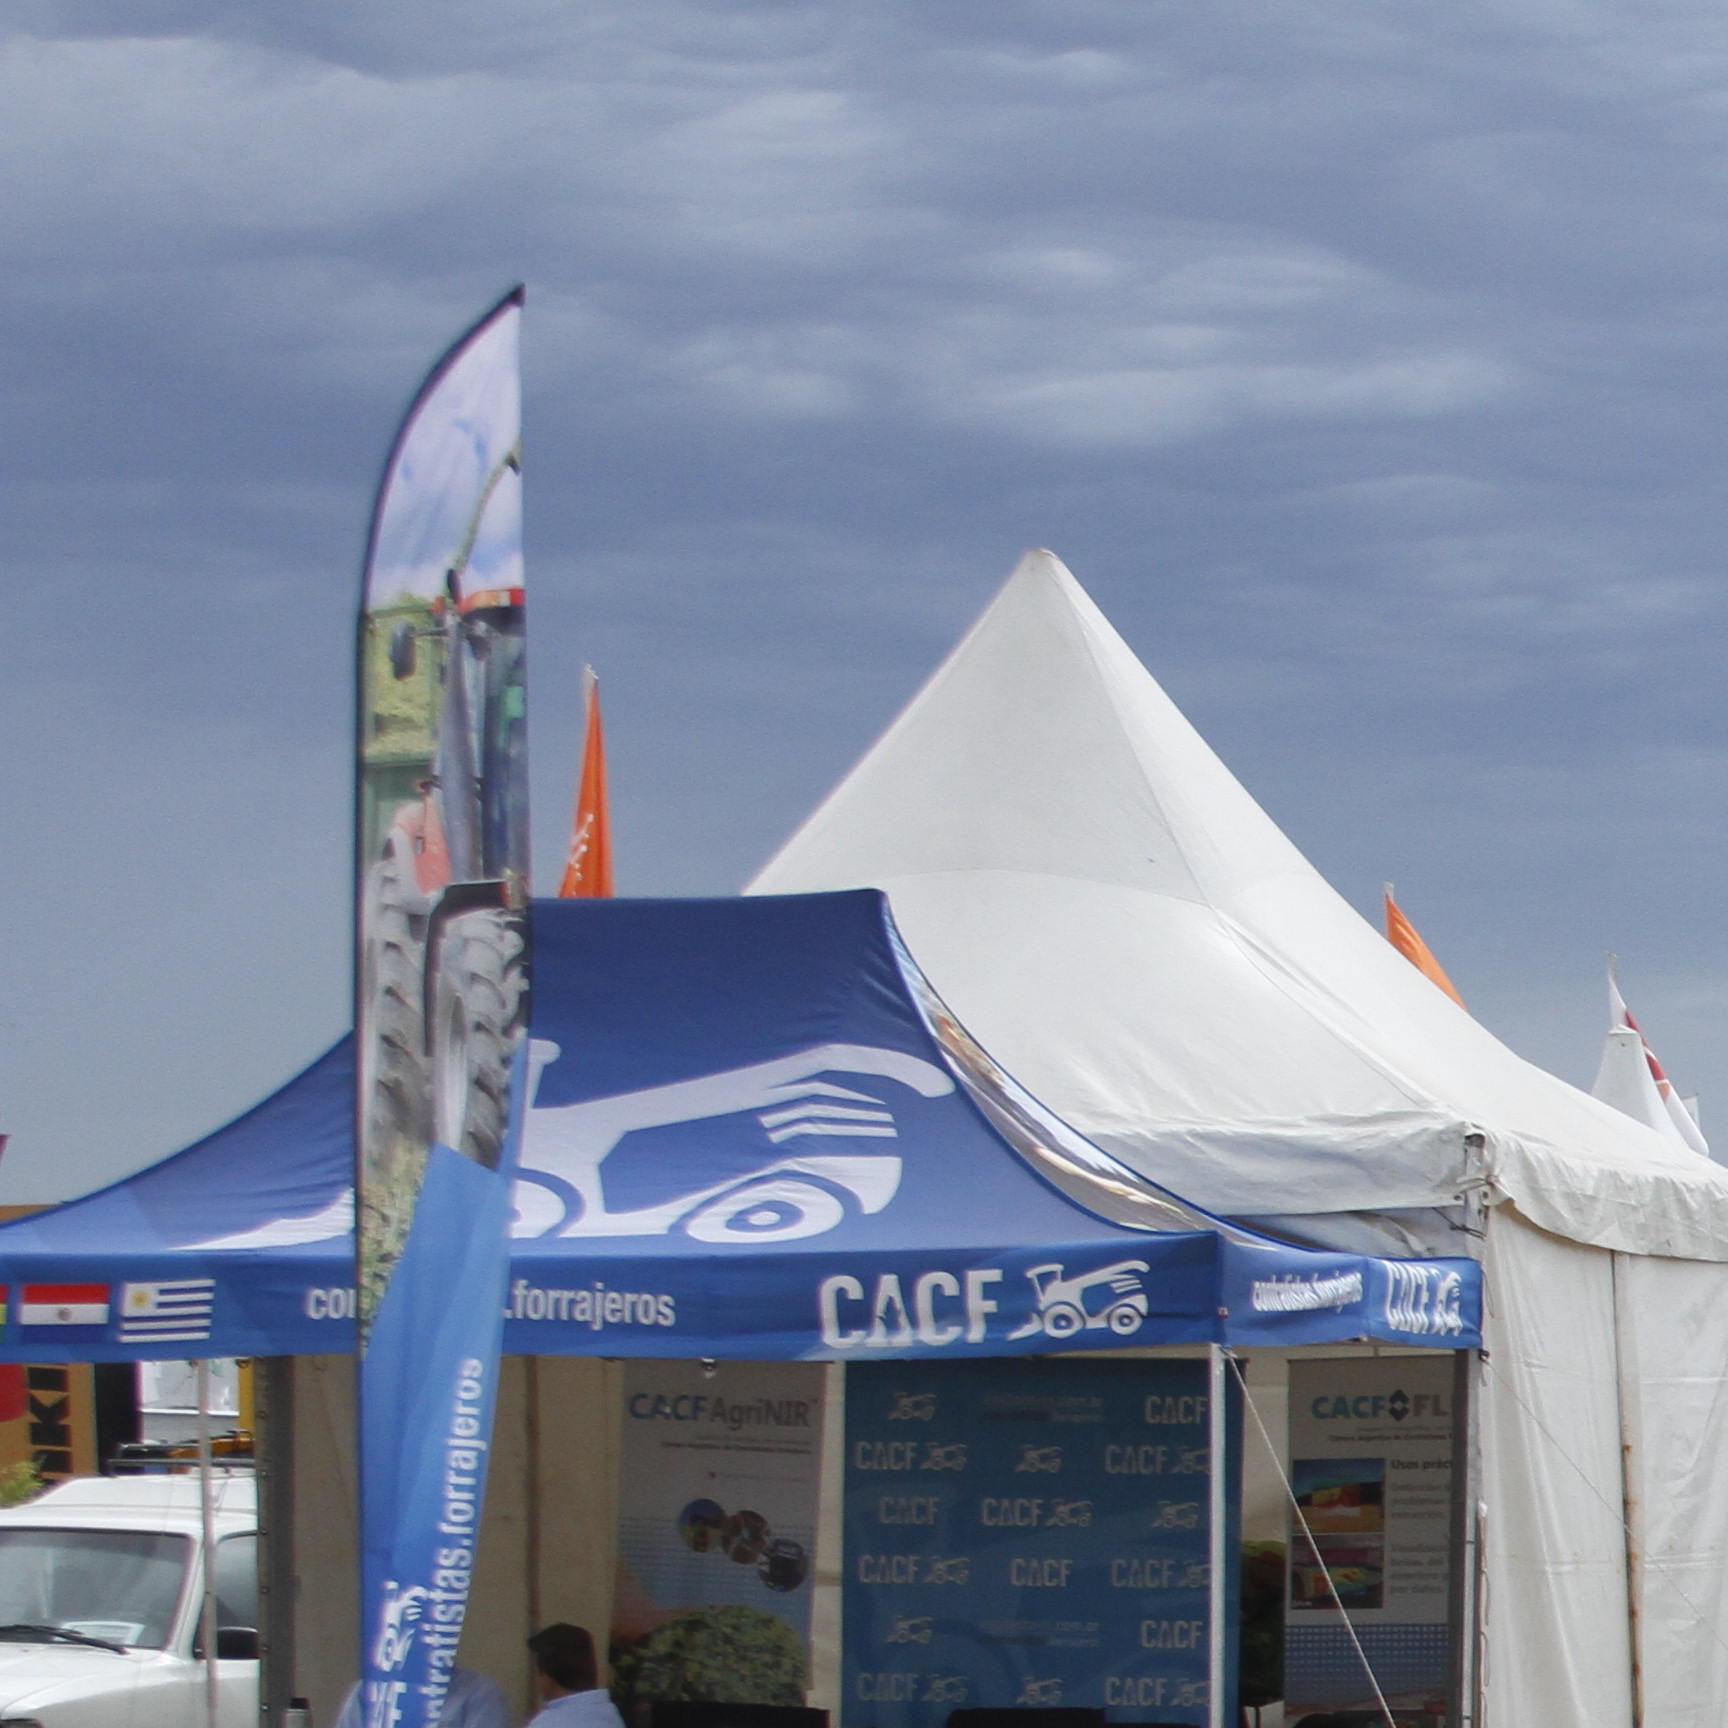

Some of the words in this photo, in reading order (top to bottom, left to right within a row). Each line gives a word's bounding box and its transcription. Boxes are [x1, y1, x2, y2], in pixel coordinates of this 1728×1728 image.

[819, 1269, 1004, 1349] CACF
[627, 1392, 708, 1421] CACF
[708, 1396, 811, 1432] AgriNIR
[1144, 1394, 1208, 1425] CACF
[1310, 1394, 1387, 1420] CACF
[1412, 1394, 1450, 1417] FL
[854, 1440, 918, 1471] CACF
[1104, 1445, 1167, 1475] CACF
[879, 1496, 940, 1526] CACF
[981, 1498, 1044, 1527] CACF
[857, 1554, 921, 1585] CACF
[1010, 1557, 1074, 1588] CACF
[1110, 1558, 1175, 1589] CACF
[1139, 1620, 1204, 1650] CACF
[857, 1672, 919, 1702] CACF
[1104, 1676, 1168, 1707] CACF
